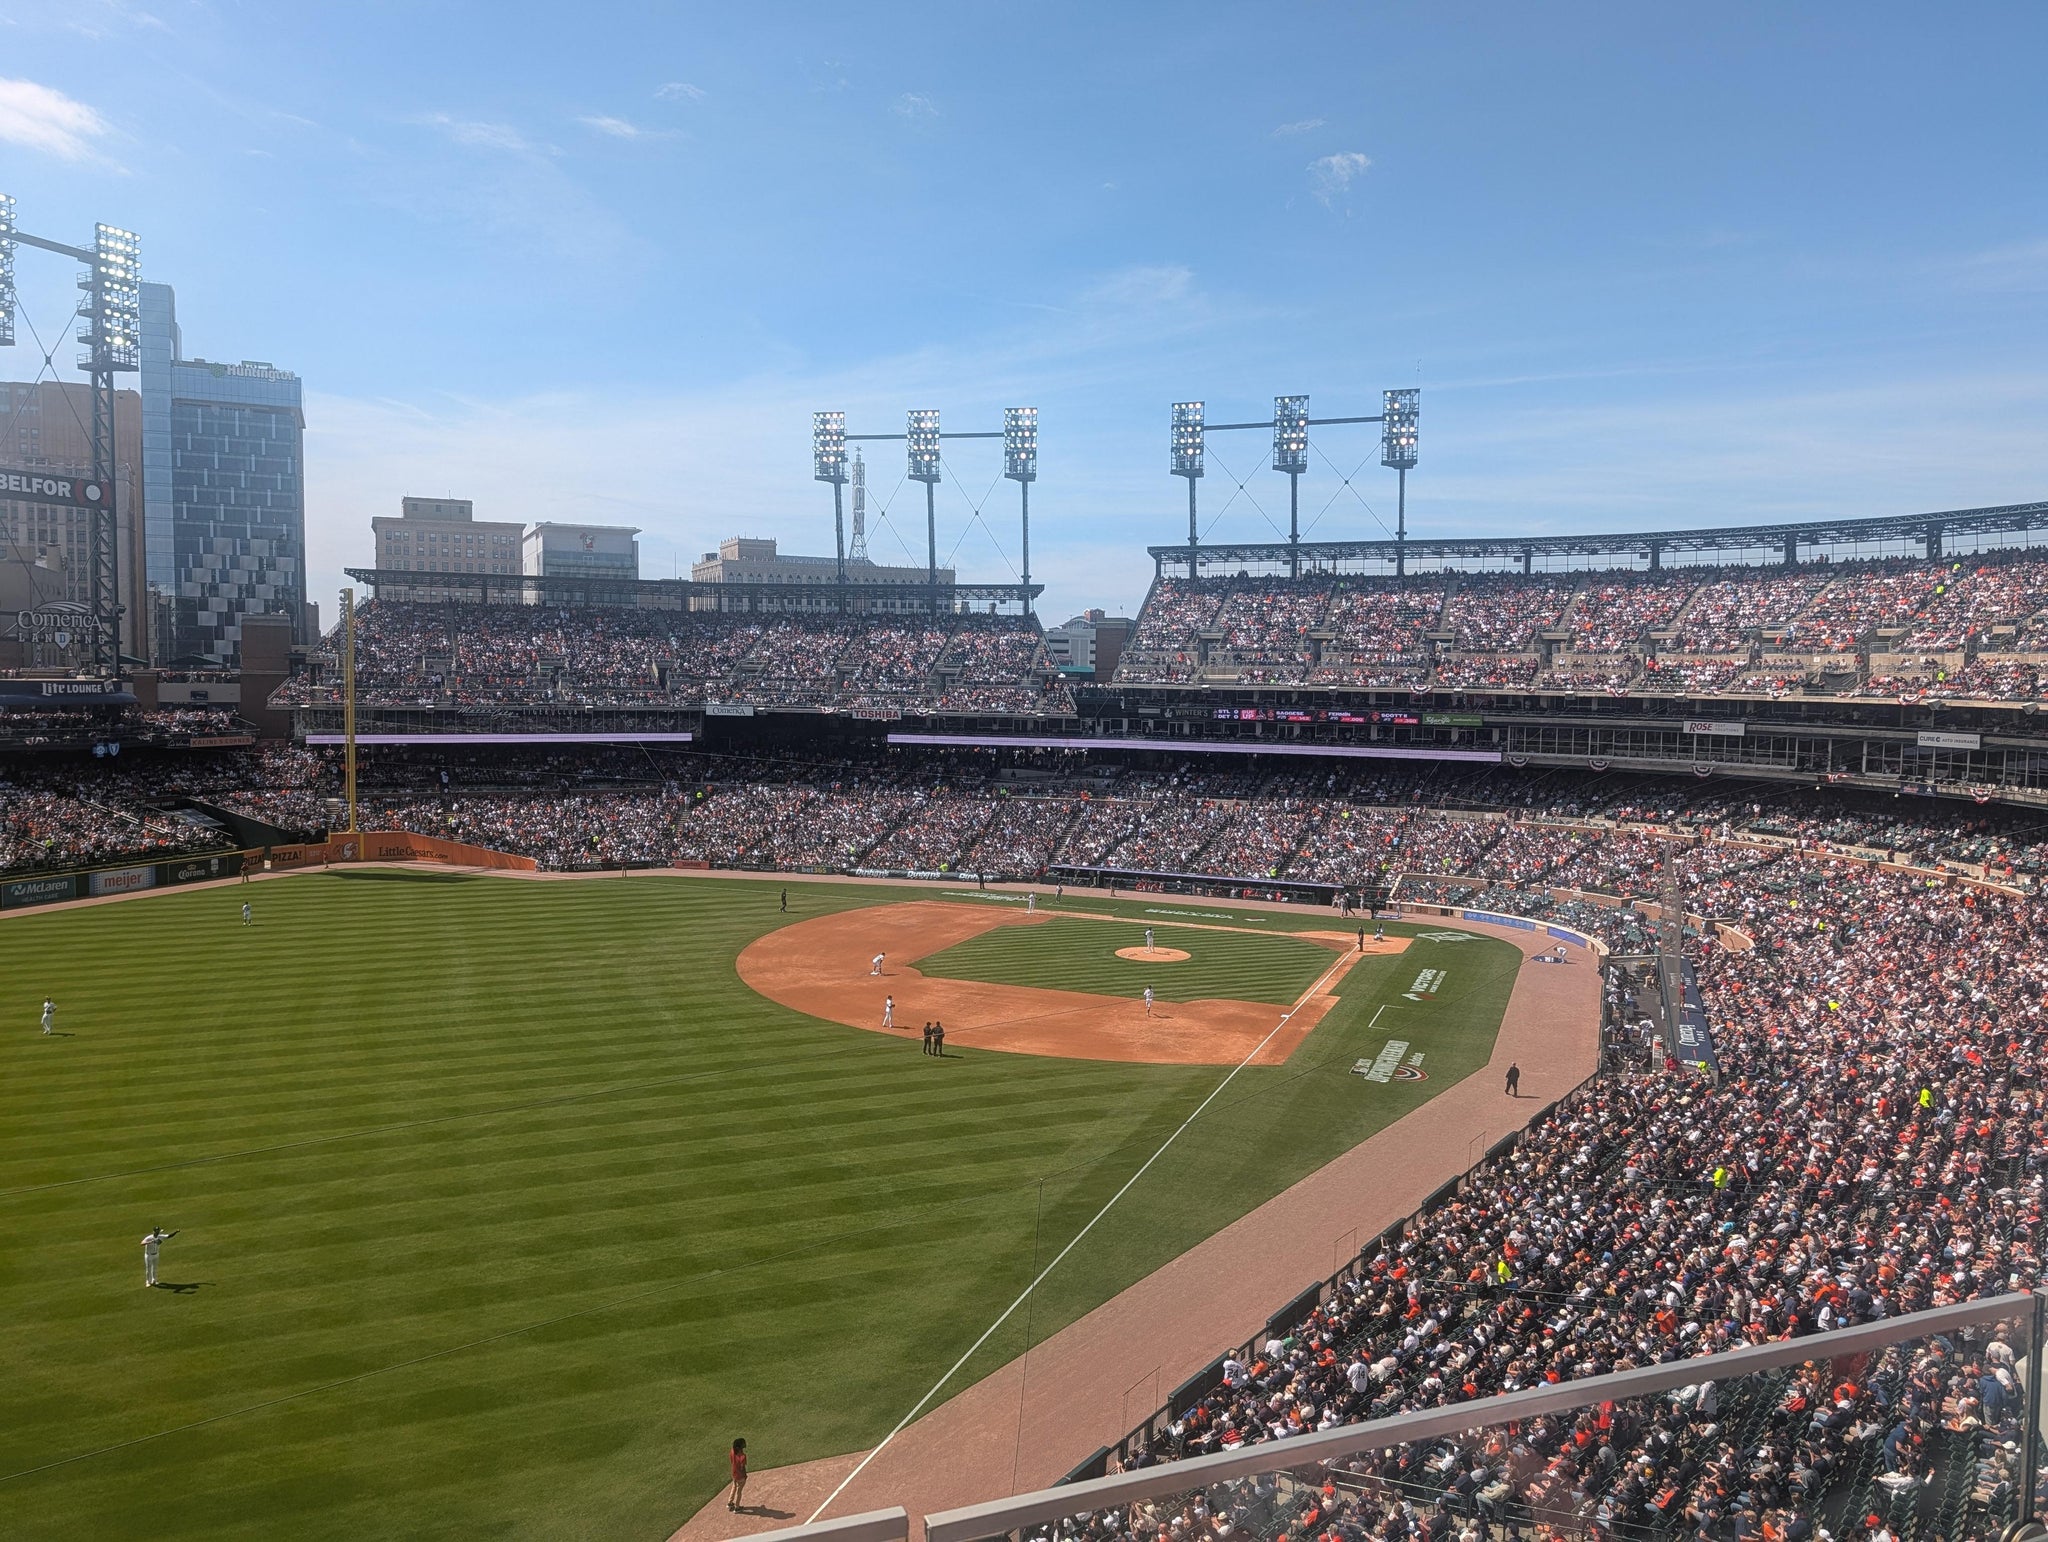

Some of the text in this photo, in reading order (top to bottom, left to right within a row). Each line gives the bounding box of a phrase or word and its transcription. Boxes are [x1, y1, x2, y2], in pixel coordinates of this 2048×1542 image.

[227, 364, 296, 383] Huntington
[0, 473, 71, 498] BELFOR
[18, 632, 105, 645] LANDING
[41, 682, 102, 696] Lite LOUNGE
[854, 710, 900, 719] TOSHIBA
[1175, 709, 1208, 717] WINTER'S
[1689, 722, 1713, 732] ROSE
[272, 850, 302, 863] PIZZA!
[378, 846, 405, 857] Little
[178, 868, 206, 880] Corona
[801, 865, 827, 874] bet365
[104, 871, 142, 888] meijer
[27, 881, 68, 895] McLaren
[1228, 1368, 1239, 1379] 24
